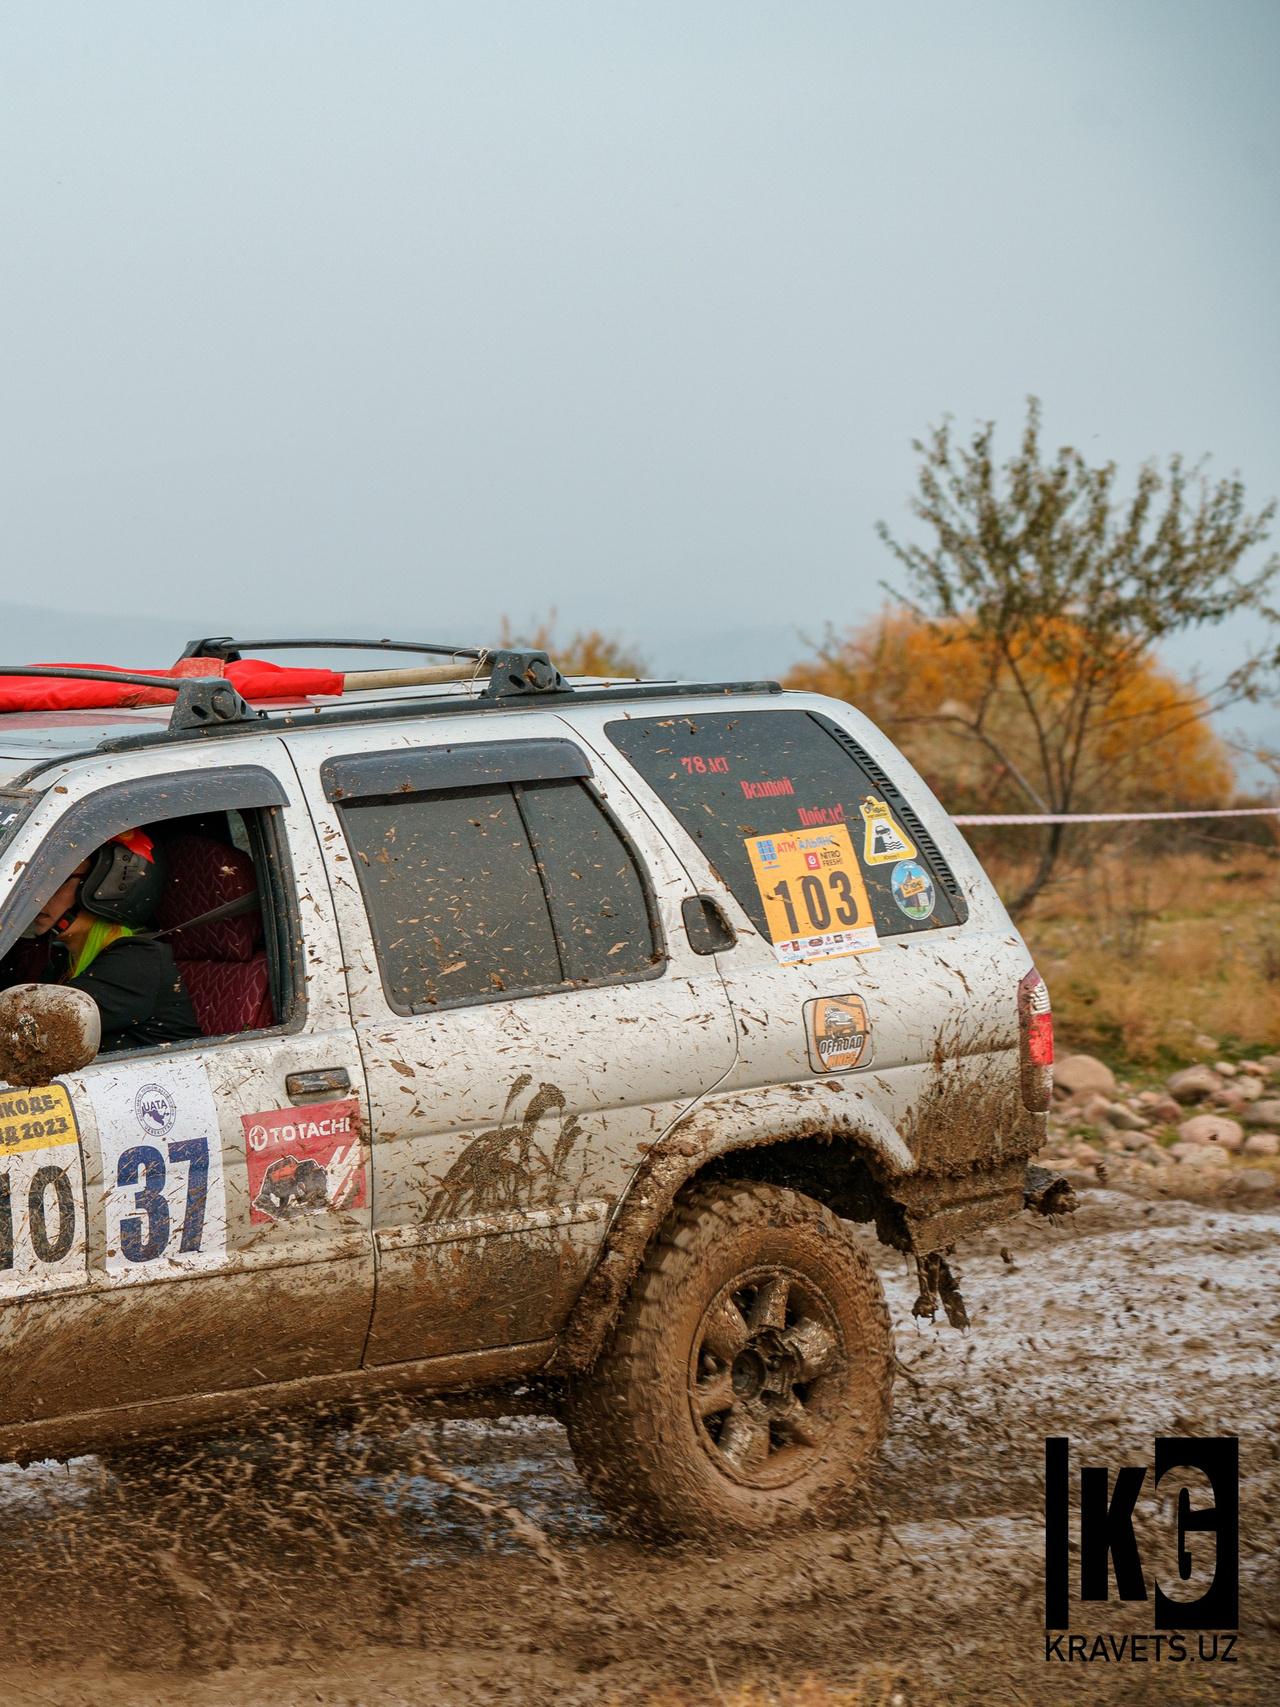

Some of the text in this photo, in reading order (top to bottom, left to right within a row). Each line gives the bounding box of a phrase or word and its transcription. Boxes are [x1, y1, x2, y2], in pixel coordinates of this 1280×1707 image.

[681, 756, 707, 774] 78
[740, 776, 795, 799] Великой
[820, 850, 841, 860] NITRO
[774, 870, 859, 935] 103
[820, 1035, 864, 1055] OFFROAD
[826, 1052, 857, 1068] KINGS
[142, 1100, 168, 1112] UATA
[20, 1117, 70, 1141] 2023
[270, 1117, 351, 1143] TOTACHI
[117, 1137, 210, 1263] 37
